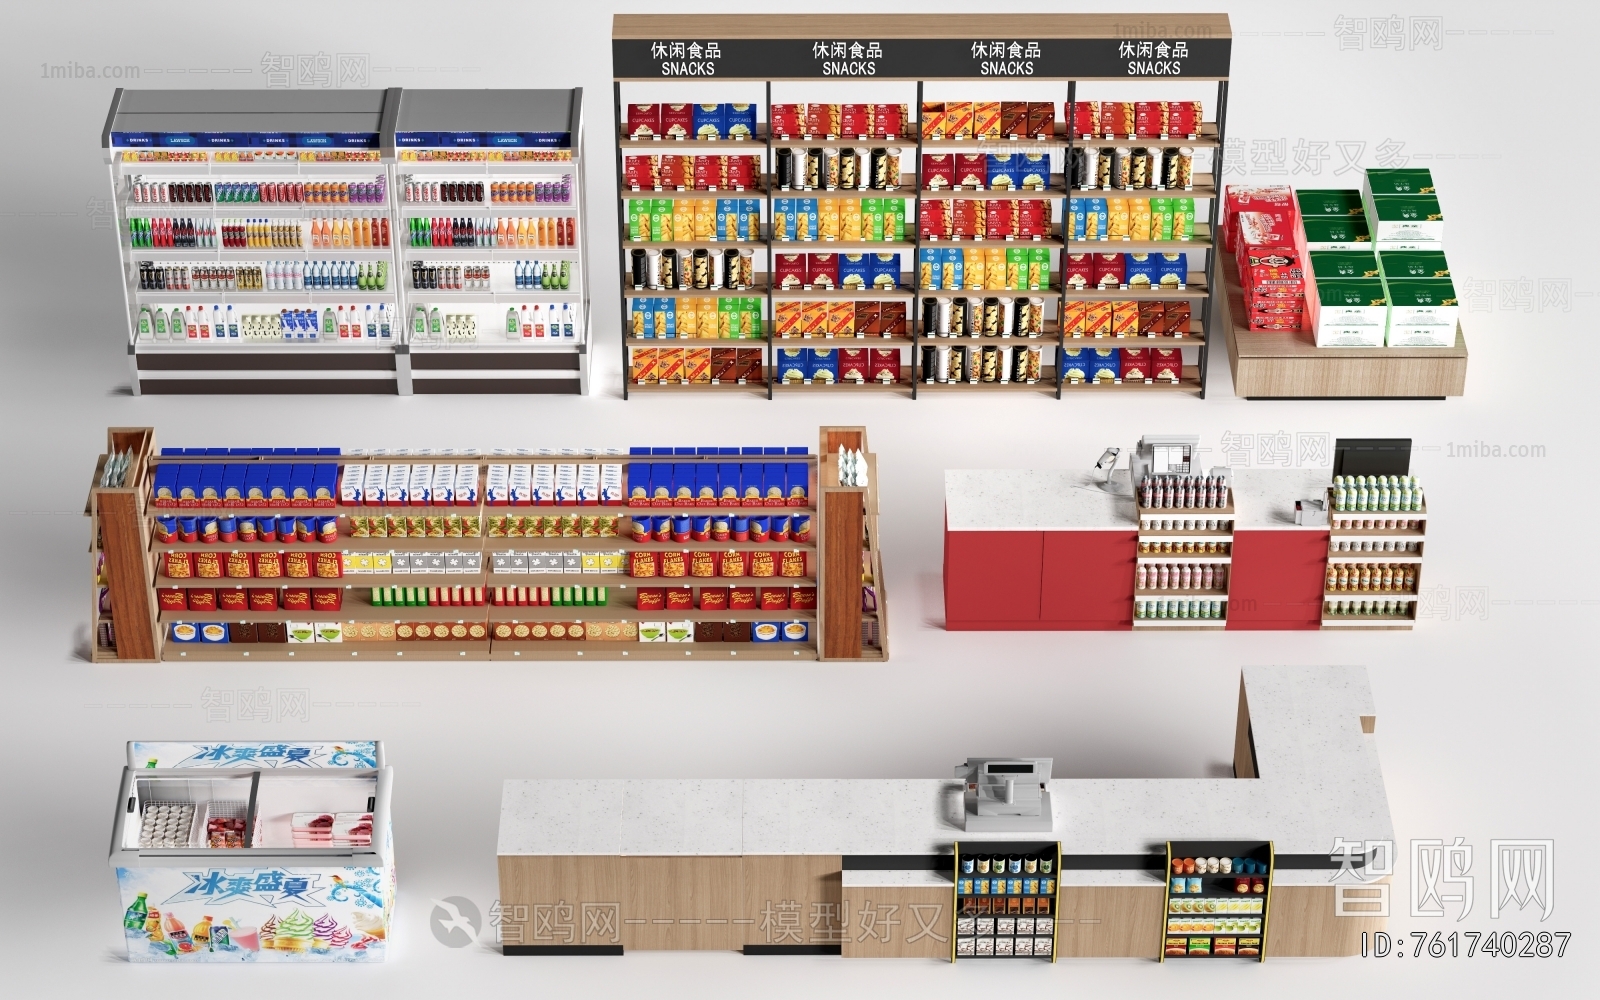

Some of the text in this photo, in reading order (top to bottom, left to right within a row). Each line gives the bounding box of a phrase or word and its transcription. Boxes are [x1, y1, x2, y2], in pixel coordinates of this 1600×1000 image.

[650, 41, 722, 59] 休闲食品
[812, 41, 883, 59] 休闲食品
[971, 41, 1041, 59] 休闲食品
[1118, 41, 1189, 59] 休闲食品
[662, 62, 714, 76] SNACKS
[822, 62, 876, 76] SNACKS
[980, 62, 1034, 76] SNACKS
[1127, 62, 1181, 76] SNACKS
[193, 744, 312, 768] 冰爽盛夏
[185, 870, 312, 904] 冰爽盛夏
